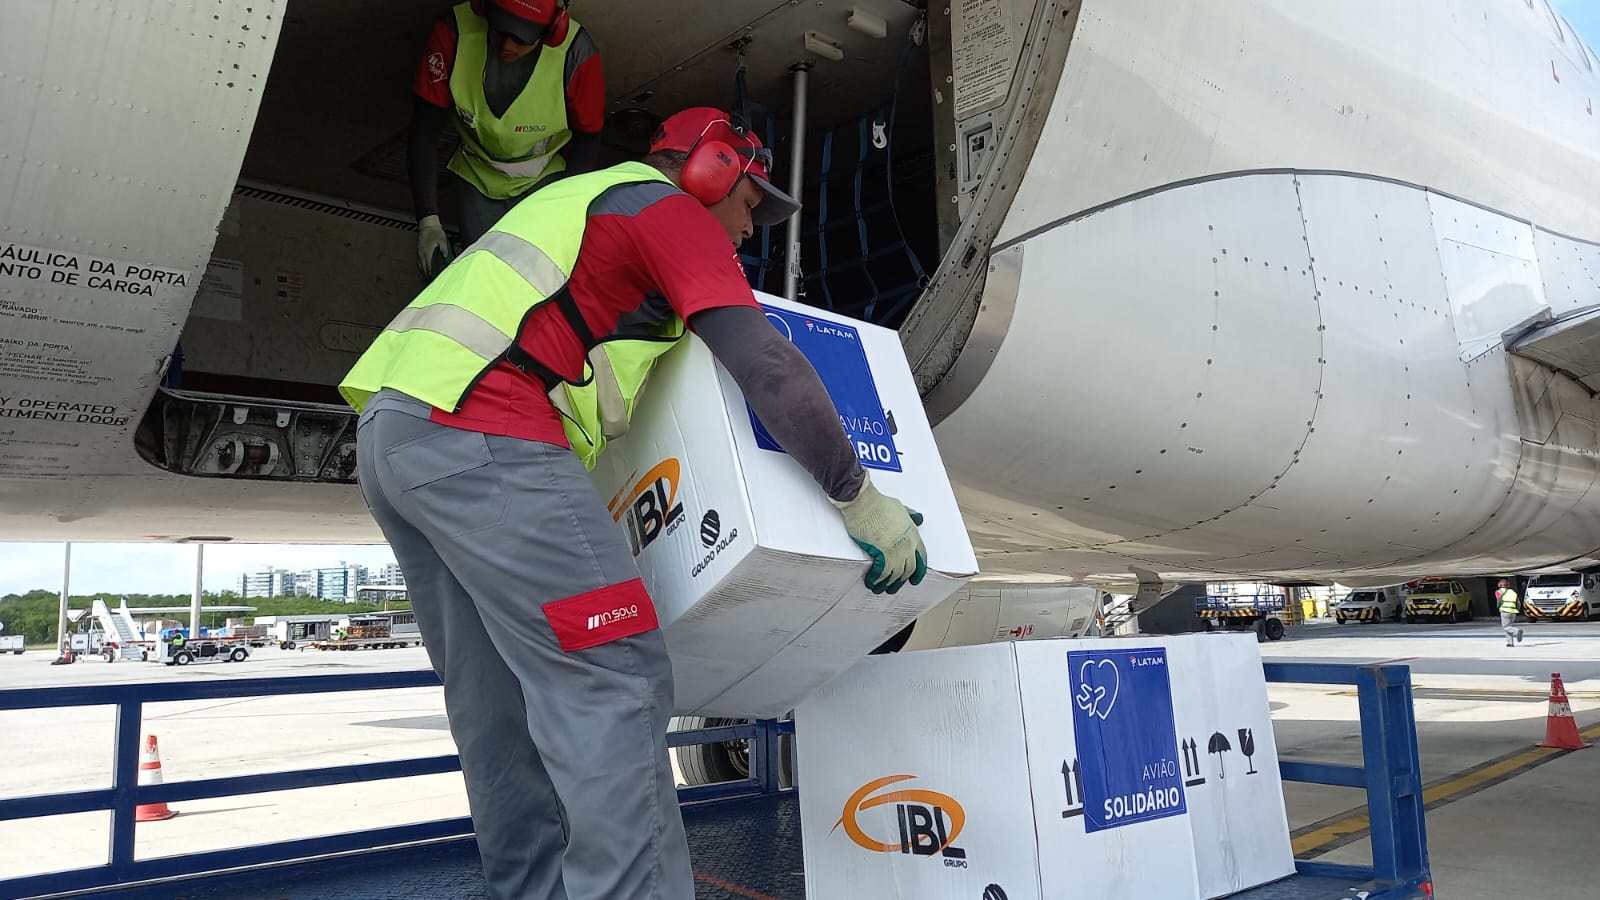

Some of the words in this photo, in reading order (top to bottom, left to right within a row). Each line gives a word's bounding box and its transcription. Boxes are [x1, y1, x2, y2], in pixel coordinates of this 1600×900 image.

[717, 151, 732, 166] 3M
[0, 244, 79, 270] ÁULICA
[89, 260, 116, 276] DA
[125, 266, 187, 287] PORTA
[0, 262, 42, 280] NTO
[51, 270, 80, 286] DE
[87, 277, 153, 297] CARGA
[816, 325, 855, 340] LATAM
[43, 343, 70, 351] PORTA
[1, 396, 11, 406] Y
[19, 399, 117, 415] OPERATED
[77, 414, 128, 426] DOOR
[840, 415, 884, 436] AVIÃO
[626, 477, 684, 557] IBL
[666, 513, 686, 536] GRUPO
[611, 604, 638, 619] SOLO
[1137, 657, 1164, 667] LATAM
[1142, 759, 1176, 782] AVIÃO
[1104, 785, 1180, 820] SOLIDÁRIO
[896, 804, 967, 859] IBL
[944, 859, 968, 869] GRUPO
